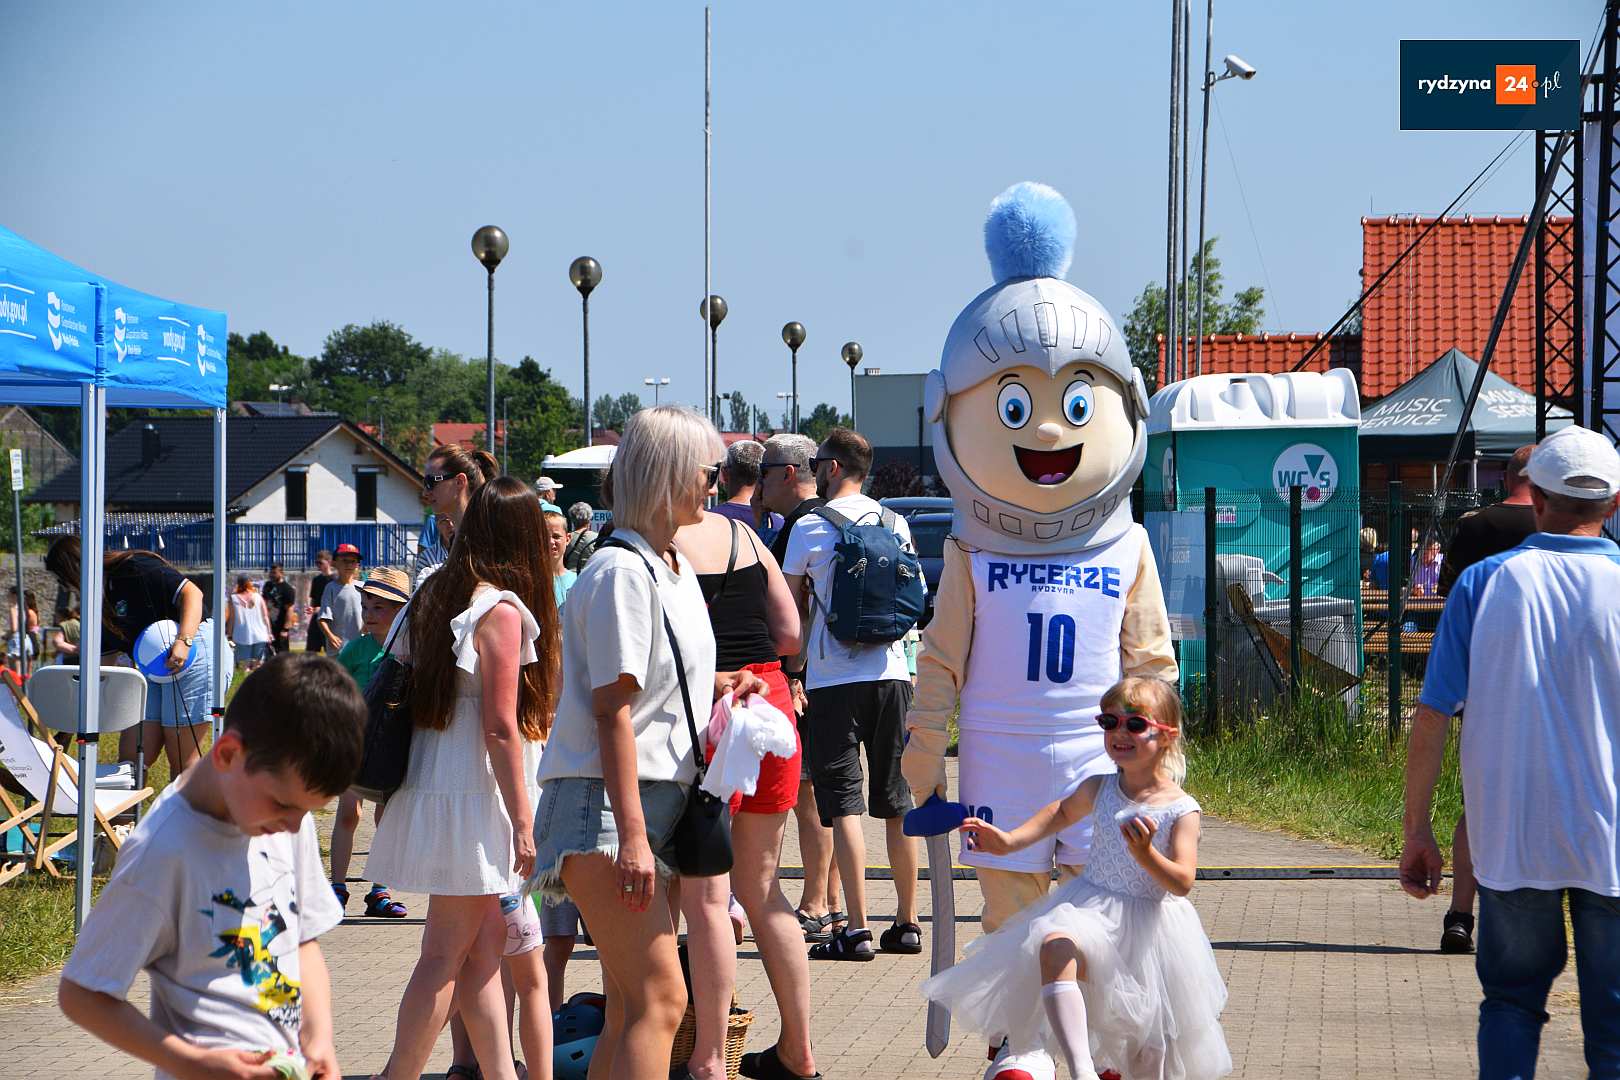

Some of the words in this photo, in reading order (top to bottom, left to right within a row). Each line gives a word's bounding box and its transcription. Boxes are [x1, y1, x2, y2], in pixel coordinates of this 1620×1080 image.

[1373, 398, 1452, 417] MUSIC
[988, 562, 1120, 598] RYCERZE
[1026, 612, 1076, 684] 10
